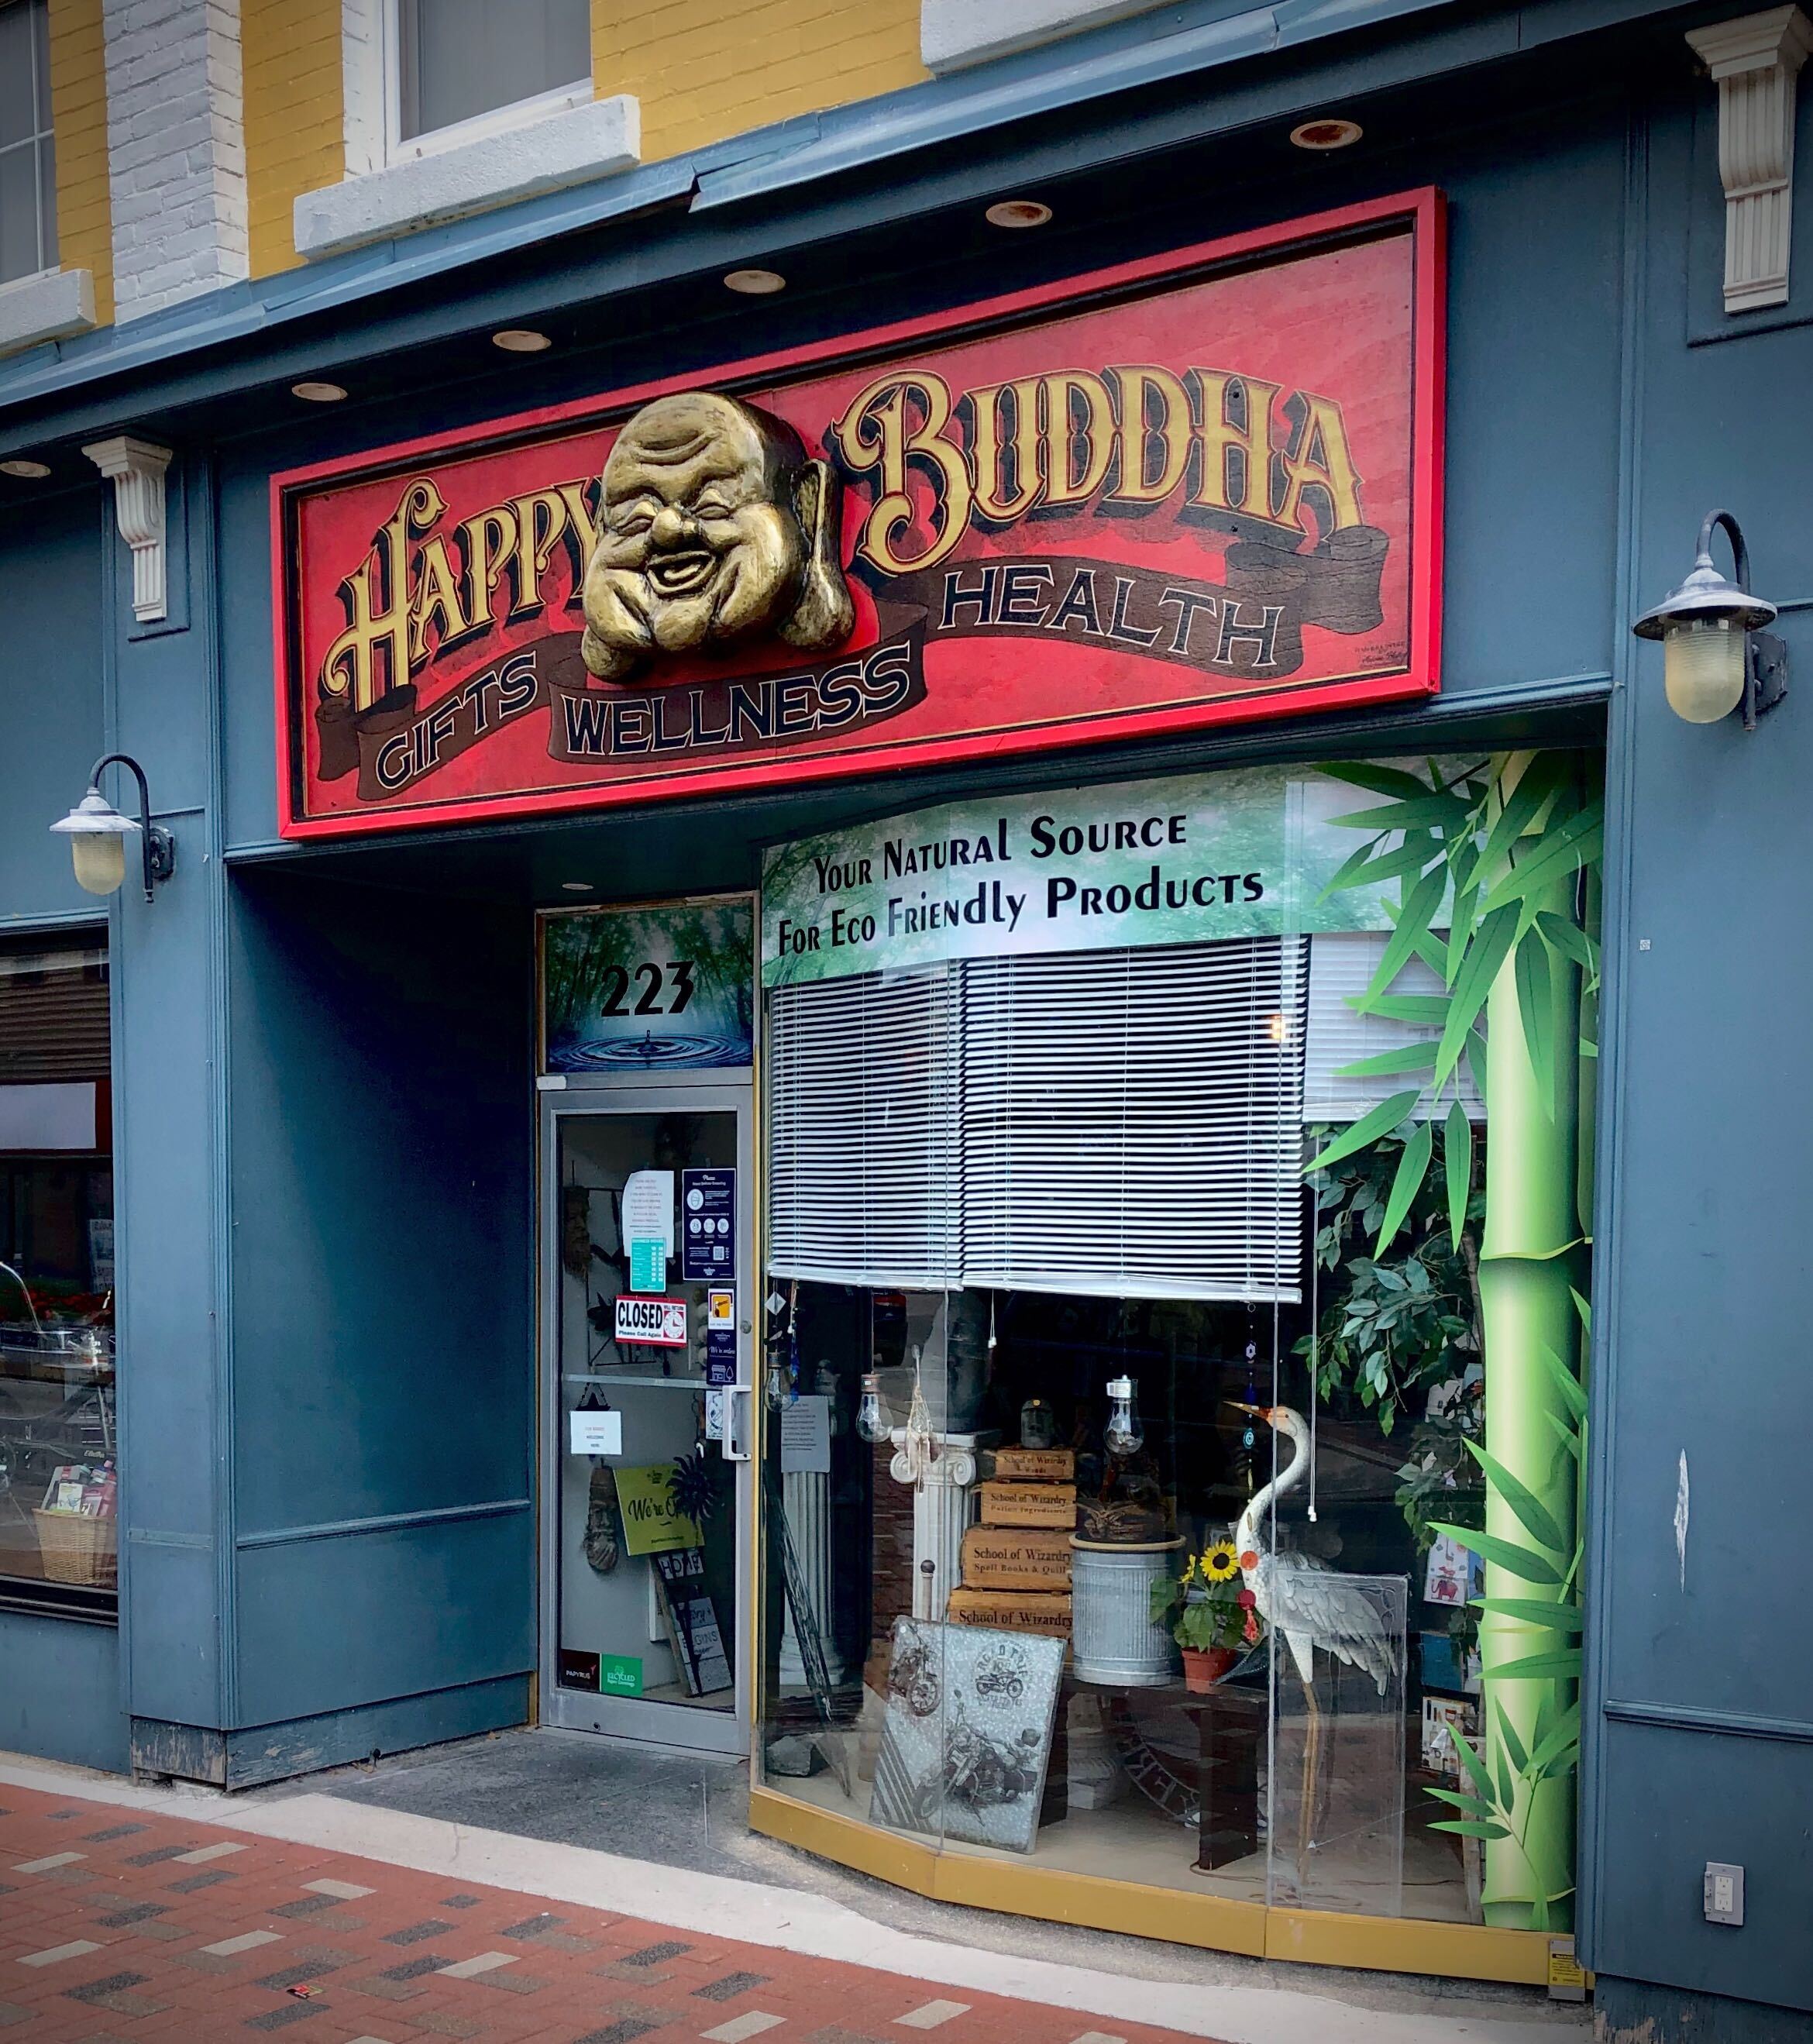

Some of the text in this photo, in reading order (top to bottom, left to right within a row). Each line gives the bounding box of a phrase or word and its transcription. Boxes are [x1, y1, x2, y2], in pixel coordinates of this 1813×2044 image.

[831, 364, 1365, 577] BUDDHA
[937, 564, 1285, 666] HEALTH
[562, 639, 912, 755] WELLNESS
[375, 649, 538, 790] GIFTS
[601, 961, 695, 1017] 223
[618, 1302, 662, 1330] CLOSED
[628, 1498, 664, 1522] We're
[991, 1493, 1067, 1506] School of Wizardry
[974, 1547, 1072, 1565] School of Wizardry
[974, 1564, 997, 1574] Spell
[1001, 1564, 1028, 1573] Books
[959, 1609, 1072, 1629] School of Wizardry
[566, 1670, 590, 1680] PAPYRUS
[607, 1672, 635, 1682] RECYCLED
